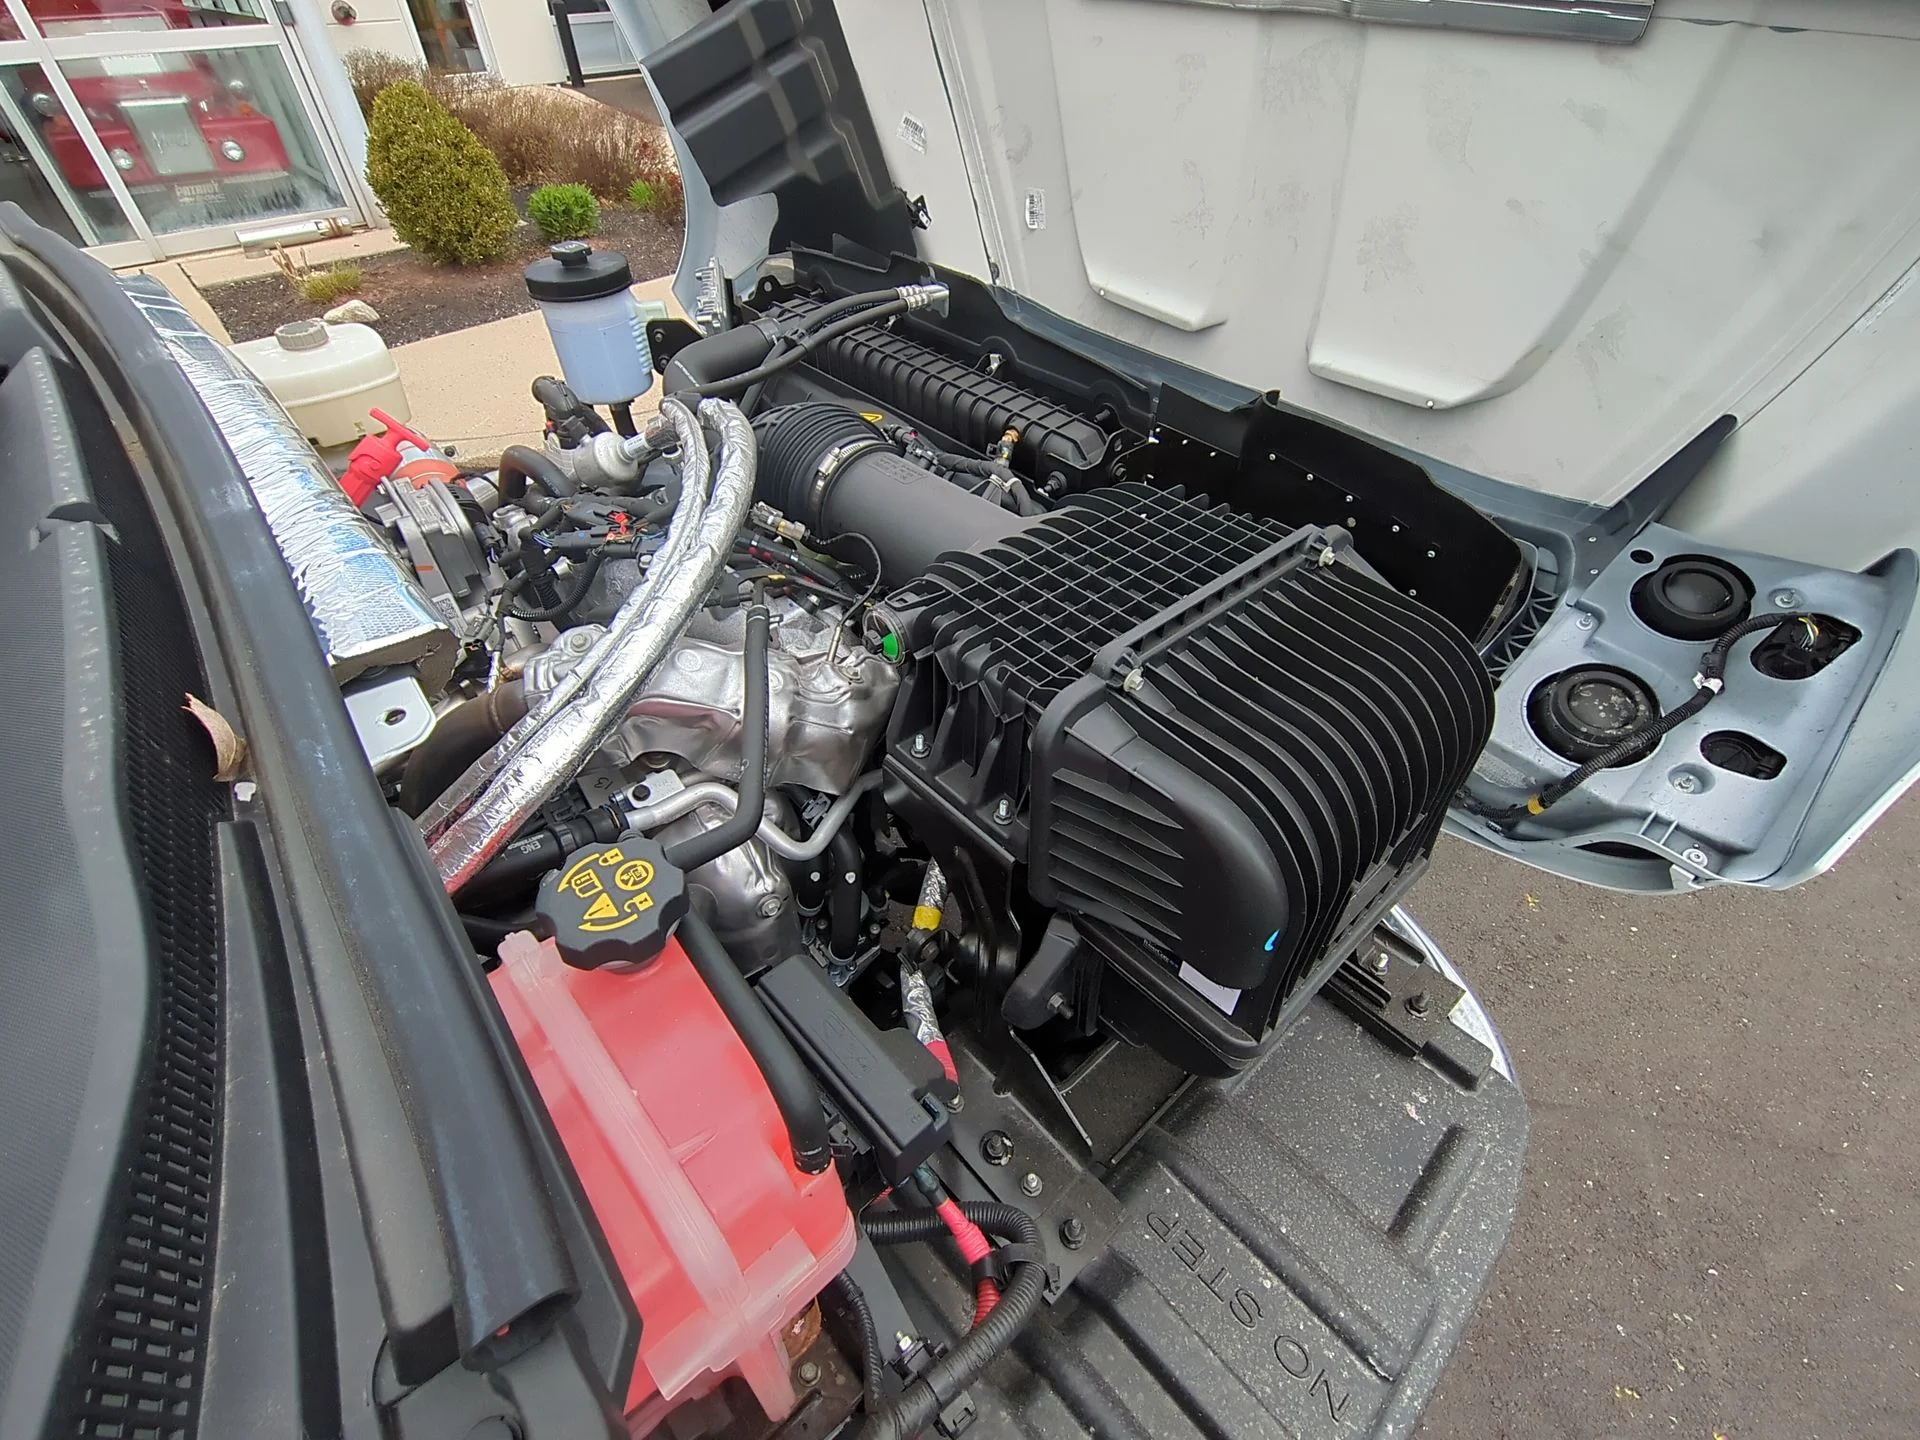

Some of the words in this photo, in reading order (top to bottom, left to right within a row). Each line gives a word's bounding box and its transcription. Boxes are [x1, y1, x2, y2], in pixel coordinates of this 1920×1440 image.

[519, 840, 542, 855] ENG
[1146, 1212, 1265, 1329] STEP
[1274, 1334, 1351, 1424] NO
